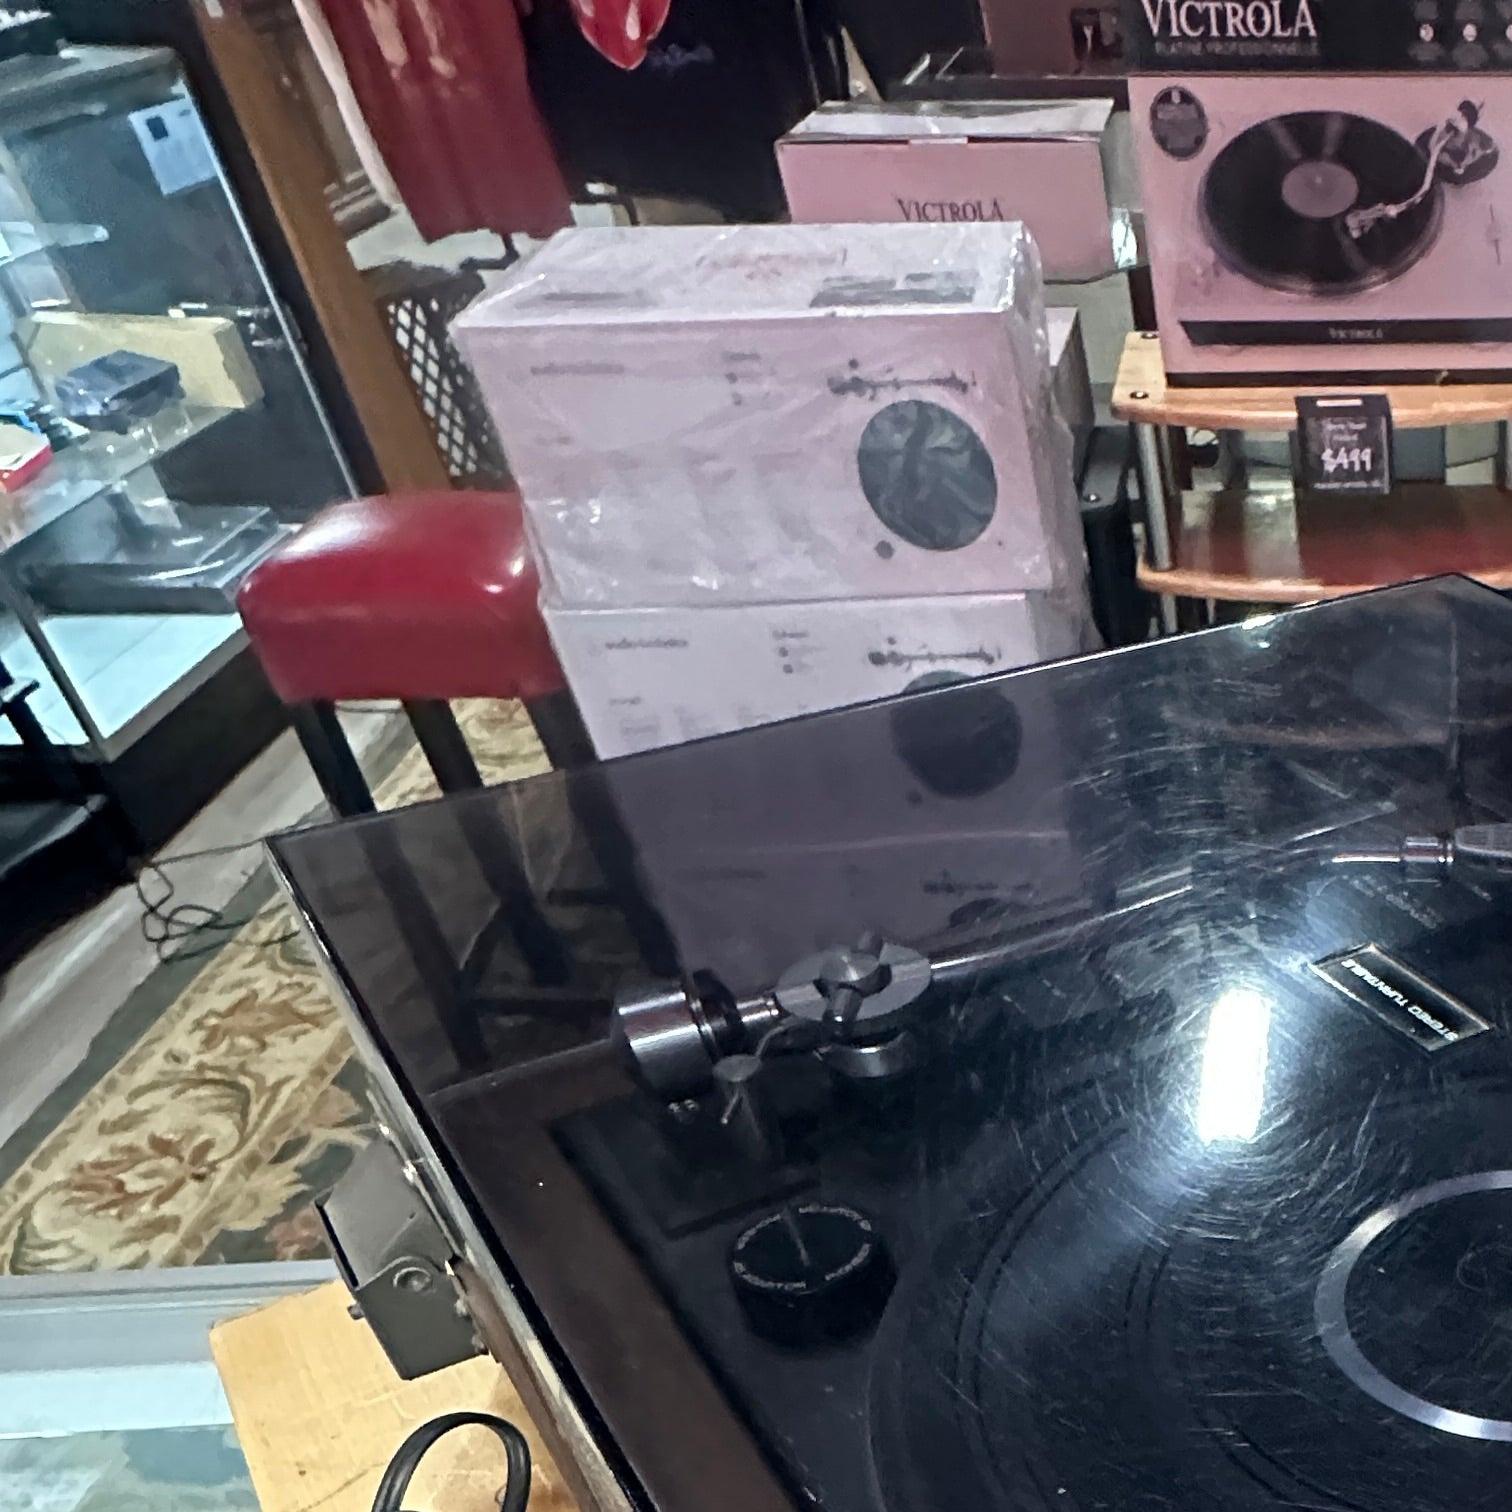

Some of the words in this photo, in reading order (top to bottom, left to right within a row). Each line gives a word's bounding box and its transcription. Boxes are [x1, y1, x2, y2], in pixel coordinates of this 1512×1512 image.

[1141, 0, 1318, 37] VICTROLA
[897, 198, 1004, 221] VICTROLA
[1341, 958, 1408, 1007] TURNTABLE
[1408, 1005, 1459, 1042] STEREO
